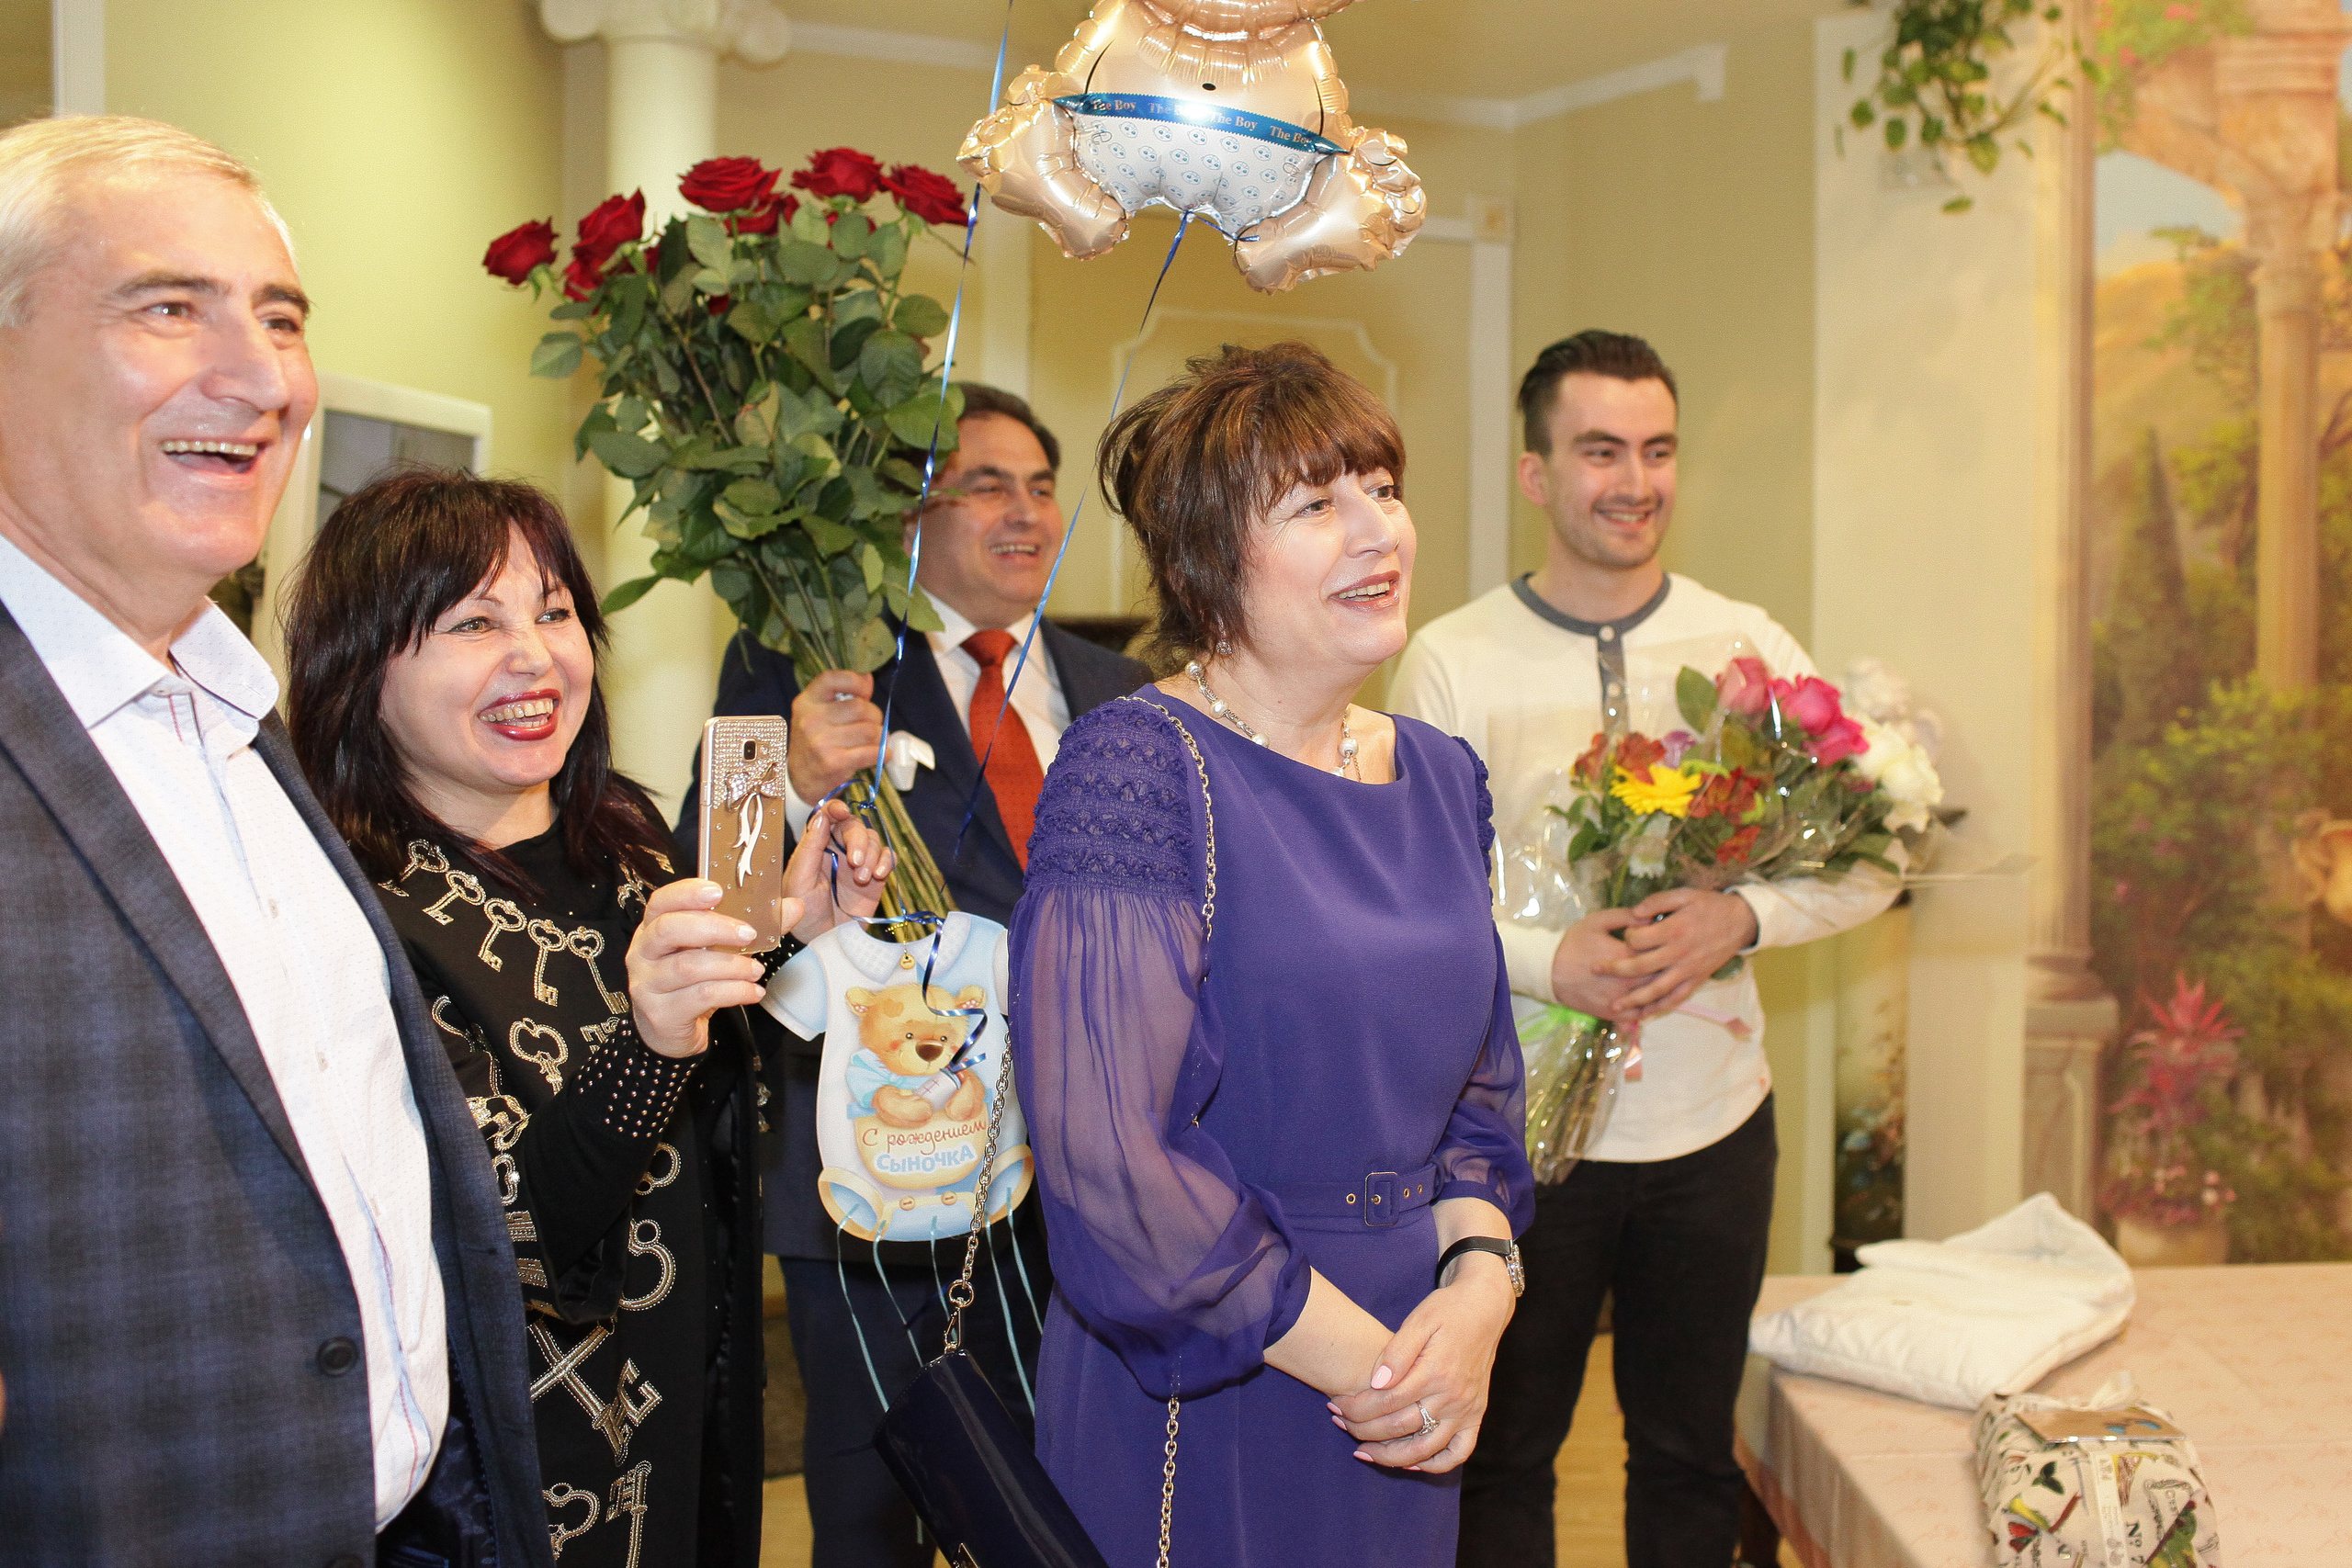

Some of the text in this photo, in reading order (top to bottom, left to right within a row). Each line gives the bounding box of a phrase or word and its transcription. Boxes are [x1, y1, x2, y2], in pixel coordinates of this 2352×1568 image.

[1091, 98, 1112, 110] Te
[1114, 99, 1136, 112] Boy
[1148, 102, 1169, 114] The
[1211, 111, 1232, 125] The
[1235, 116, 1258, 131] Boy
[1270, 125, 1291, 141] The
[862, 1121, 987, 1156] С рождением
[876, 1145, 975, 1173] СЫНОЧКА
